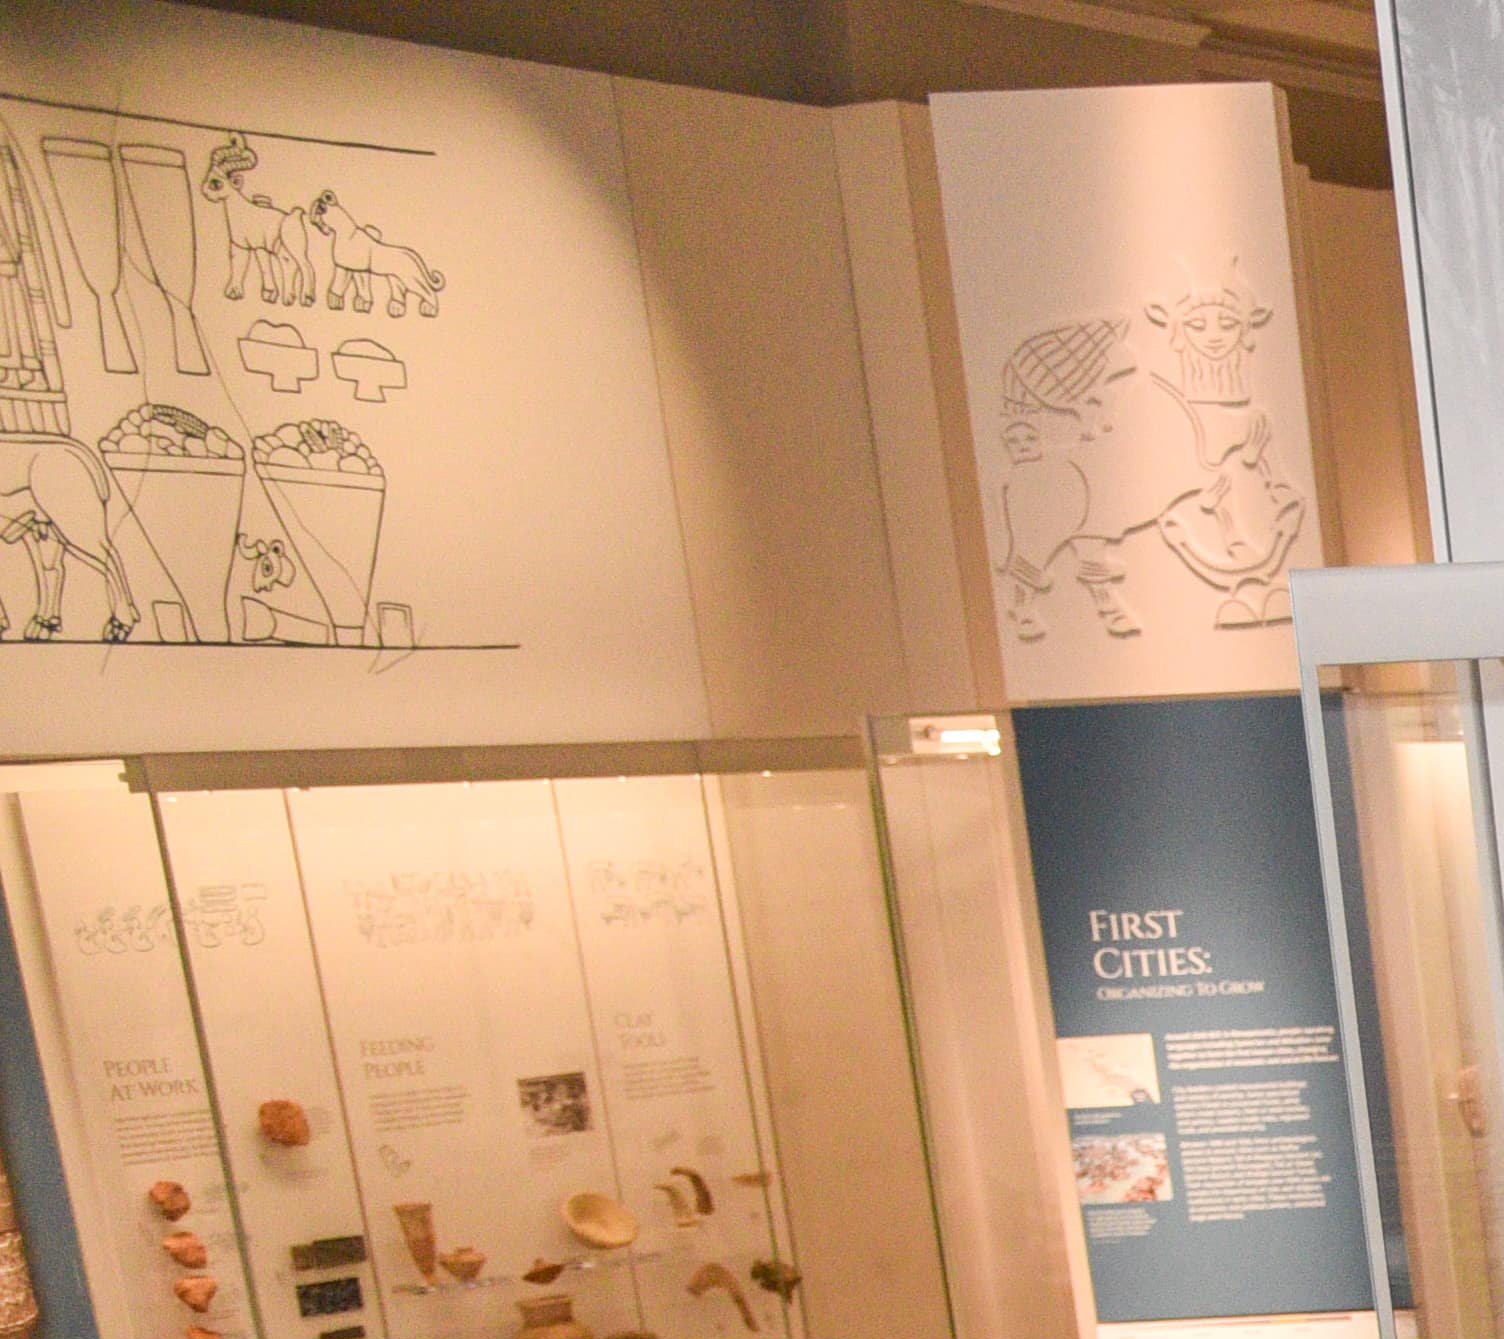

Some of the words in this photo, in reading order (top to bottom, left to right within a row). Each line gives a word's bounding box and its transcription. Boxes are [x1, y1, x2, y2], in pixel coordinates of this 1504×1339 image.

[1089, 909, 1183, 942] FIRST
[1093, 946, 1213, 979] CITIES:
[103, 1058, 170, 1078] PEOPLE
[364, 1061, 425, 1080] PEOPLE
[111, 1084, 135, 1102] AT
[136, 1079, 199, 1097] WORK
